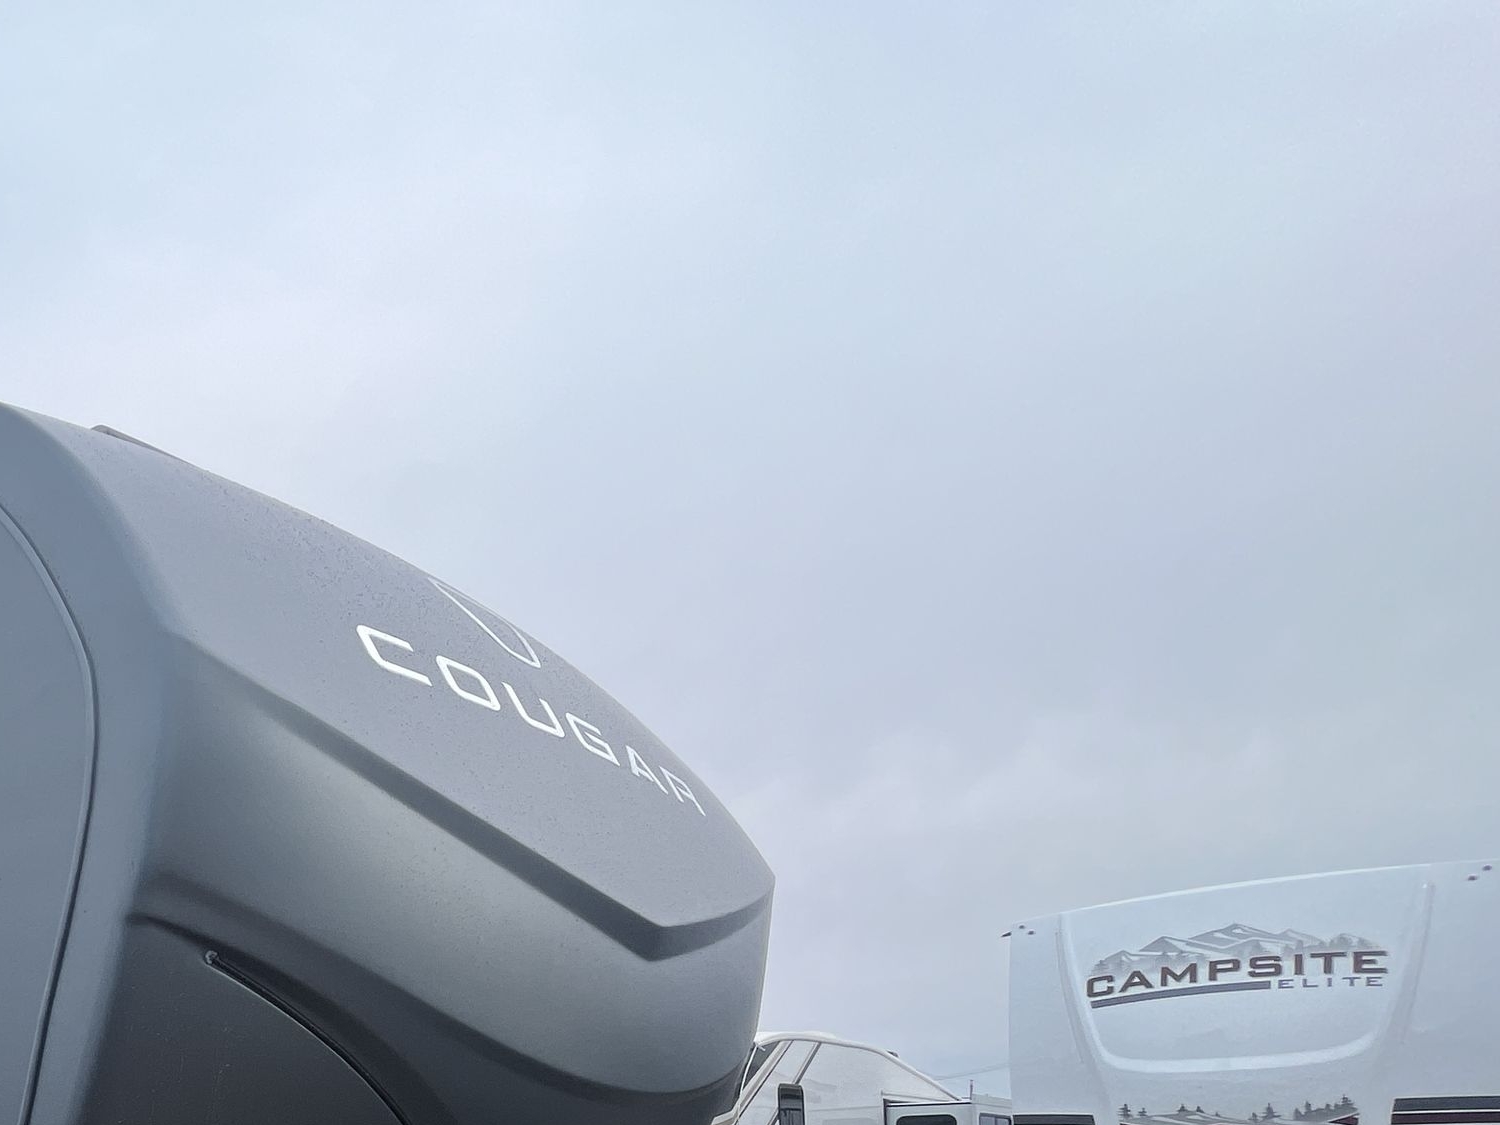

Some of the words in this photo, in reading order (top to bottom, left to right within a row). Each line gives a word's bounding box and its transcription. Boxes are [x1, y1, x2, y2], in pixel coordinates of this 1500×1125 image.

[356, 624, 706, 816] COUGAR
[1086, 950, 1388, 998] CAMPSITE
[1277, 976, 1384, 990] ELITE
